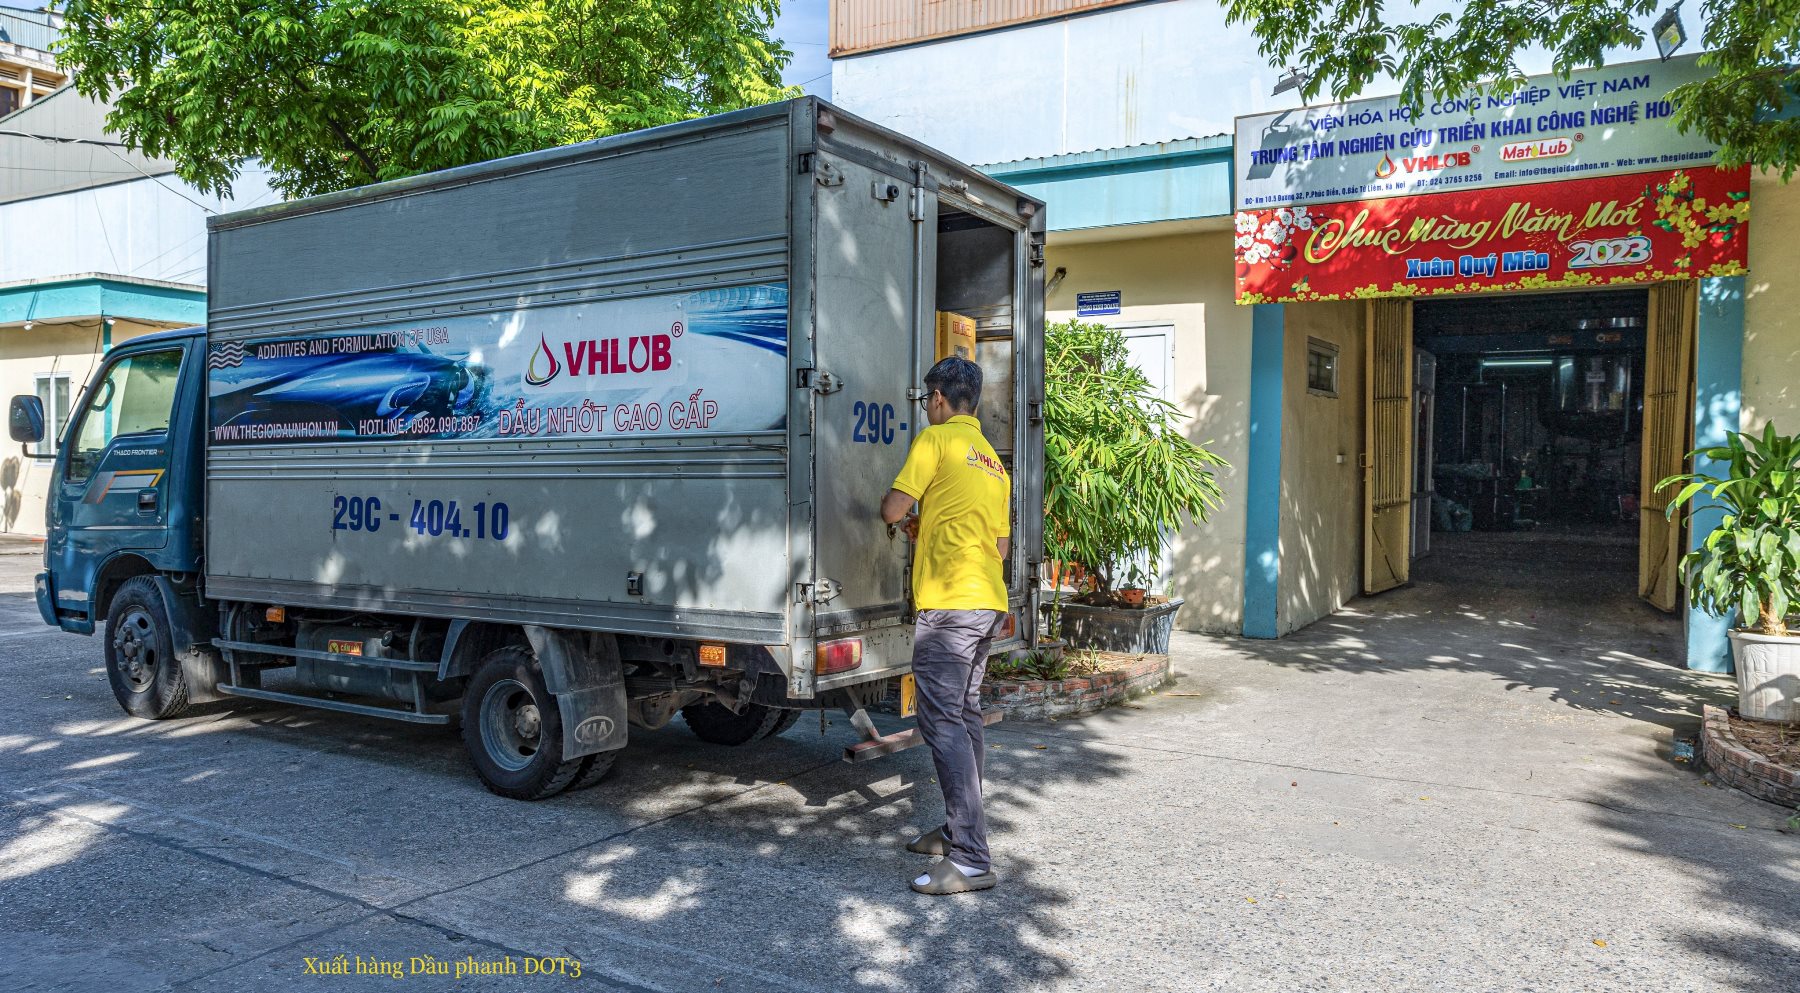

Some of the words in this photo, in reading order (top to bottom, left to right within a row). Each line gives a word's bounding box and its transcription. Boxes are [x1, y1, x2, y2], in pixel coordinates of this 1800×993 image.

[1310, 113, 1344, 132] VIỆN
[1349, 108, 1383, 127] HÓA
[1431, 97, 1481, 116] CÔNG
[1488, 86, 1550, 109] NGHIỆP
[1557, 79, 1597, 100] VIỆT
[1603, 74, 1650, 93] NAM
[1250, 146, 1298, 165] TRUNG
[1302, 140, 1334, 161] TÂM
[1339, 132, 1395, 156] NGHIÊN
[1400, 127, 1433, 148] CỨU
[1438, 116, 1485, 143] TRIỂN
[1491, 117, 1532, 138] KHAI
[1537, 107, 1585, 131] CÔNG
[1590, 101, 1638, 126] NGHỆ
[1402, 151, 1471, 174] VHLUB
[1494, 167, 1517, 180] Email:
[1518, 160, 1609, 177] info@thegioidaunhon.vn
[1617, 158, 1636, 168] Web:
[1638, 155, 1659, 166] www.
[1660, 149, 1718, 163] thegioidaunh
[1444, 176, 1463, 184] 3765
[1304, 208, 1416, 264] Chúc
[1400, 214, 1491, 249] Mừng
[1487, 201, 1583, 242] Năm
[1577, 196, 1646, 229] Mới
[1406, 257, 1454, 279] Xuân
[1458, 253, 1498, 278] Quý
[1502, 250, 1550, 273] Mão
[1568, 236, 1652, 269] 2023
[257, 341, 307, 360] ADDITIVES
[308, 339, 330, 356] AND
[332, 331, 406, 354] FORMULATION
[408, 329, 424, 346] OF
[427, 327, 450, 345] USA
[563, 334, 672, 377] VHLUB
[359, 417, 409, 436] HOTLINE:
[411, 415, 480, 434] 0982.090.887
[499, 398, 541, 434] DẦU
[547, 399, 608, 433] NHỚT
[613, 402, 662, 431] CAO
[668, 388, 718, 430] CẤP
[853, 400, 895, 445] 29C
[214, 421, 338, 441] WWW.THEGIOIDAUNHON.VN
[333, 495, 381, 532] 29C
[409, 499, 509, 541] 404.10
[581, 721, 608, 740] KIA
